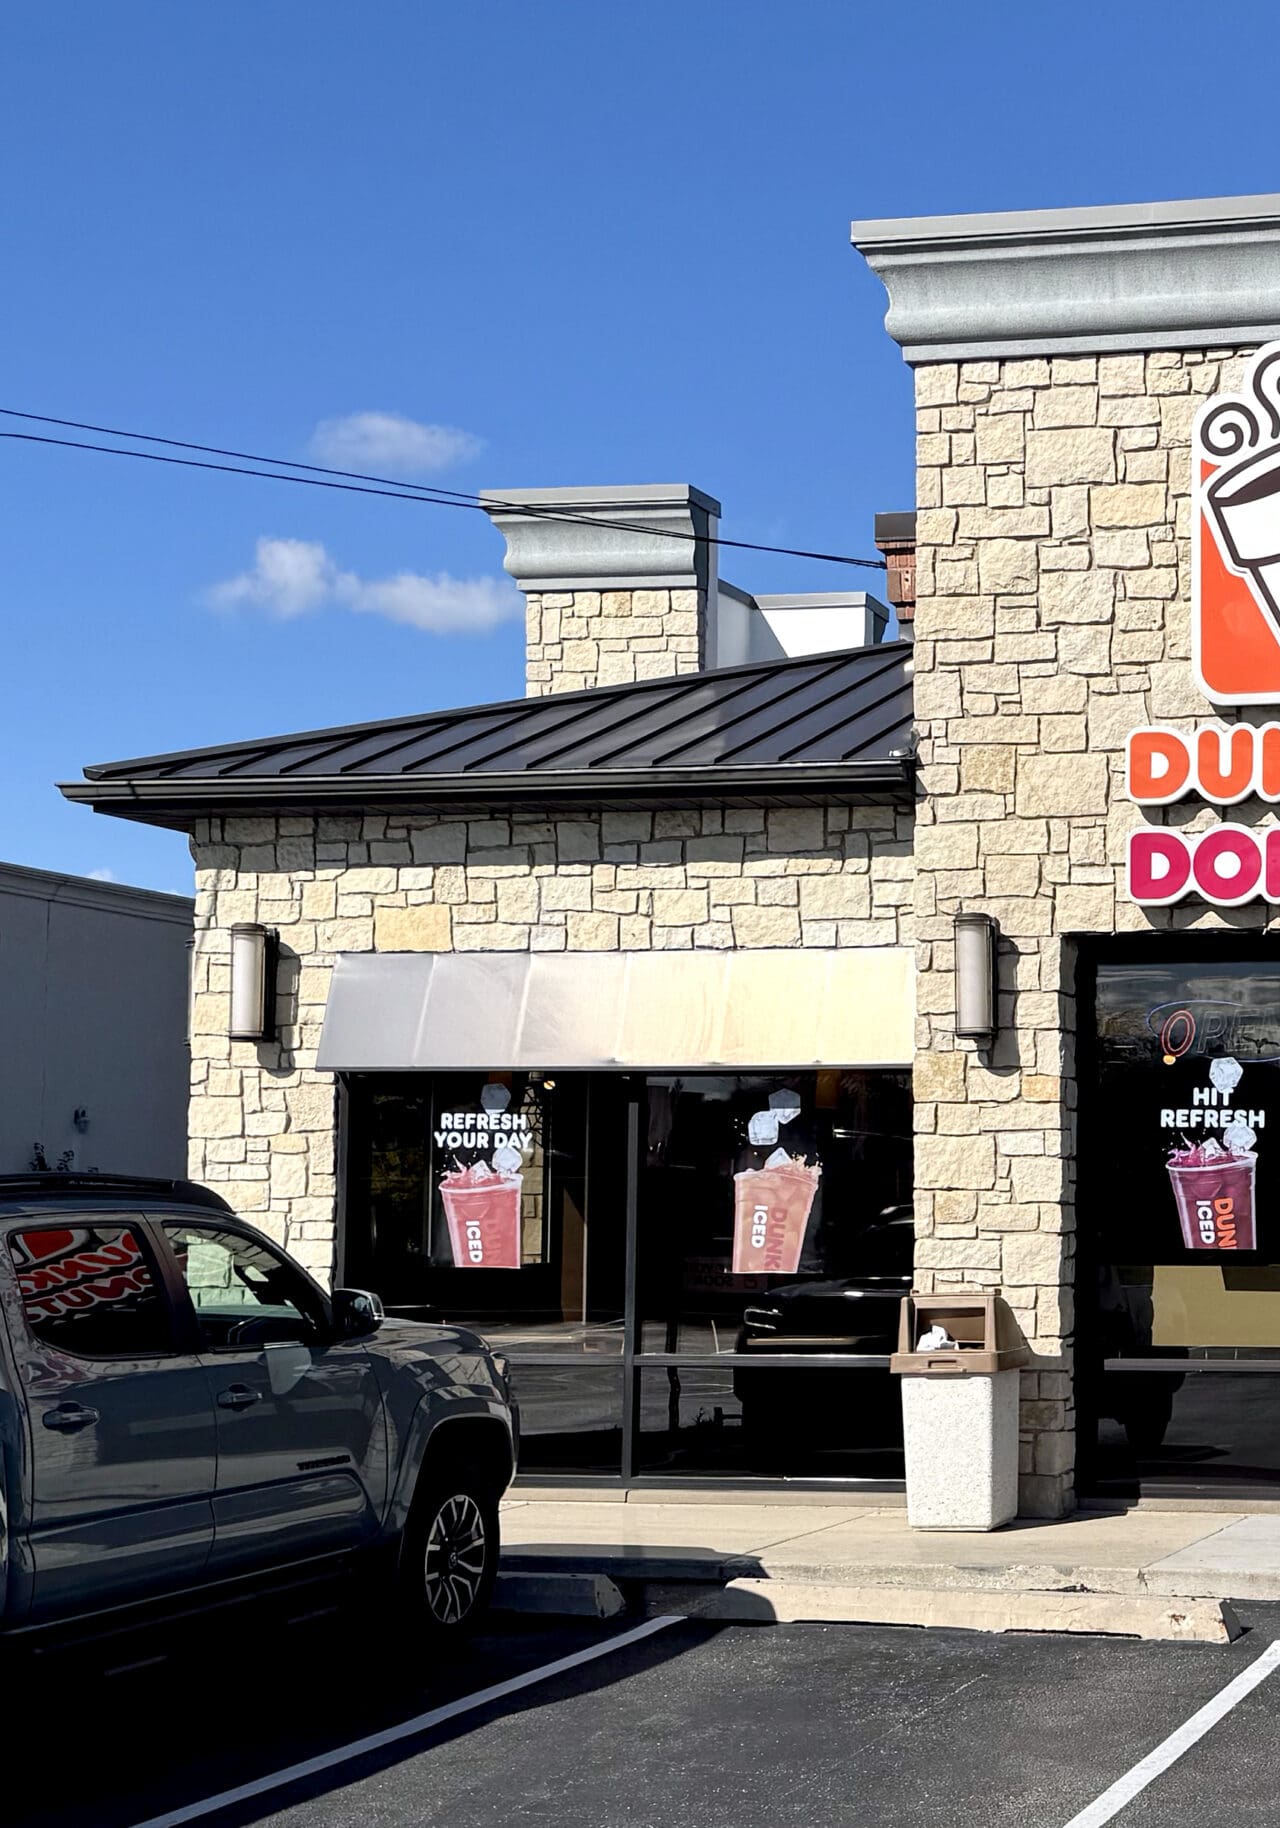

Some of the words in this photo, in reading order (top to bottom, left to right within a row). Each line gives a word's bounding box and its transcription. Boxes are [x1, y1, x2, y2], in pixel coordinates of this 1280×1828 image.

[1192, 1087, 1234, 1106] HIT
[440, 1112, 527, 1130] REFRESH
[1160, 1109, 1265, 1129] REFRESH
[433, 1131, 489, 1149] YOUR
[494, 1131, 533, 1150] DAY
[750, 1205, 769, 1249] ICED
[1196, 1199, 1215, 1245] ICED
[1214, 1198, 1238, 1250] DUN
[465, 1220, 484, 1263] ICED
